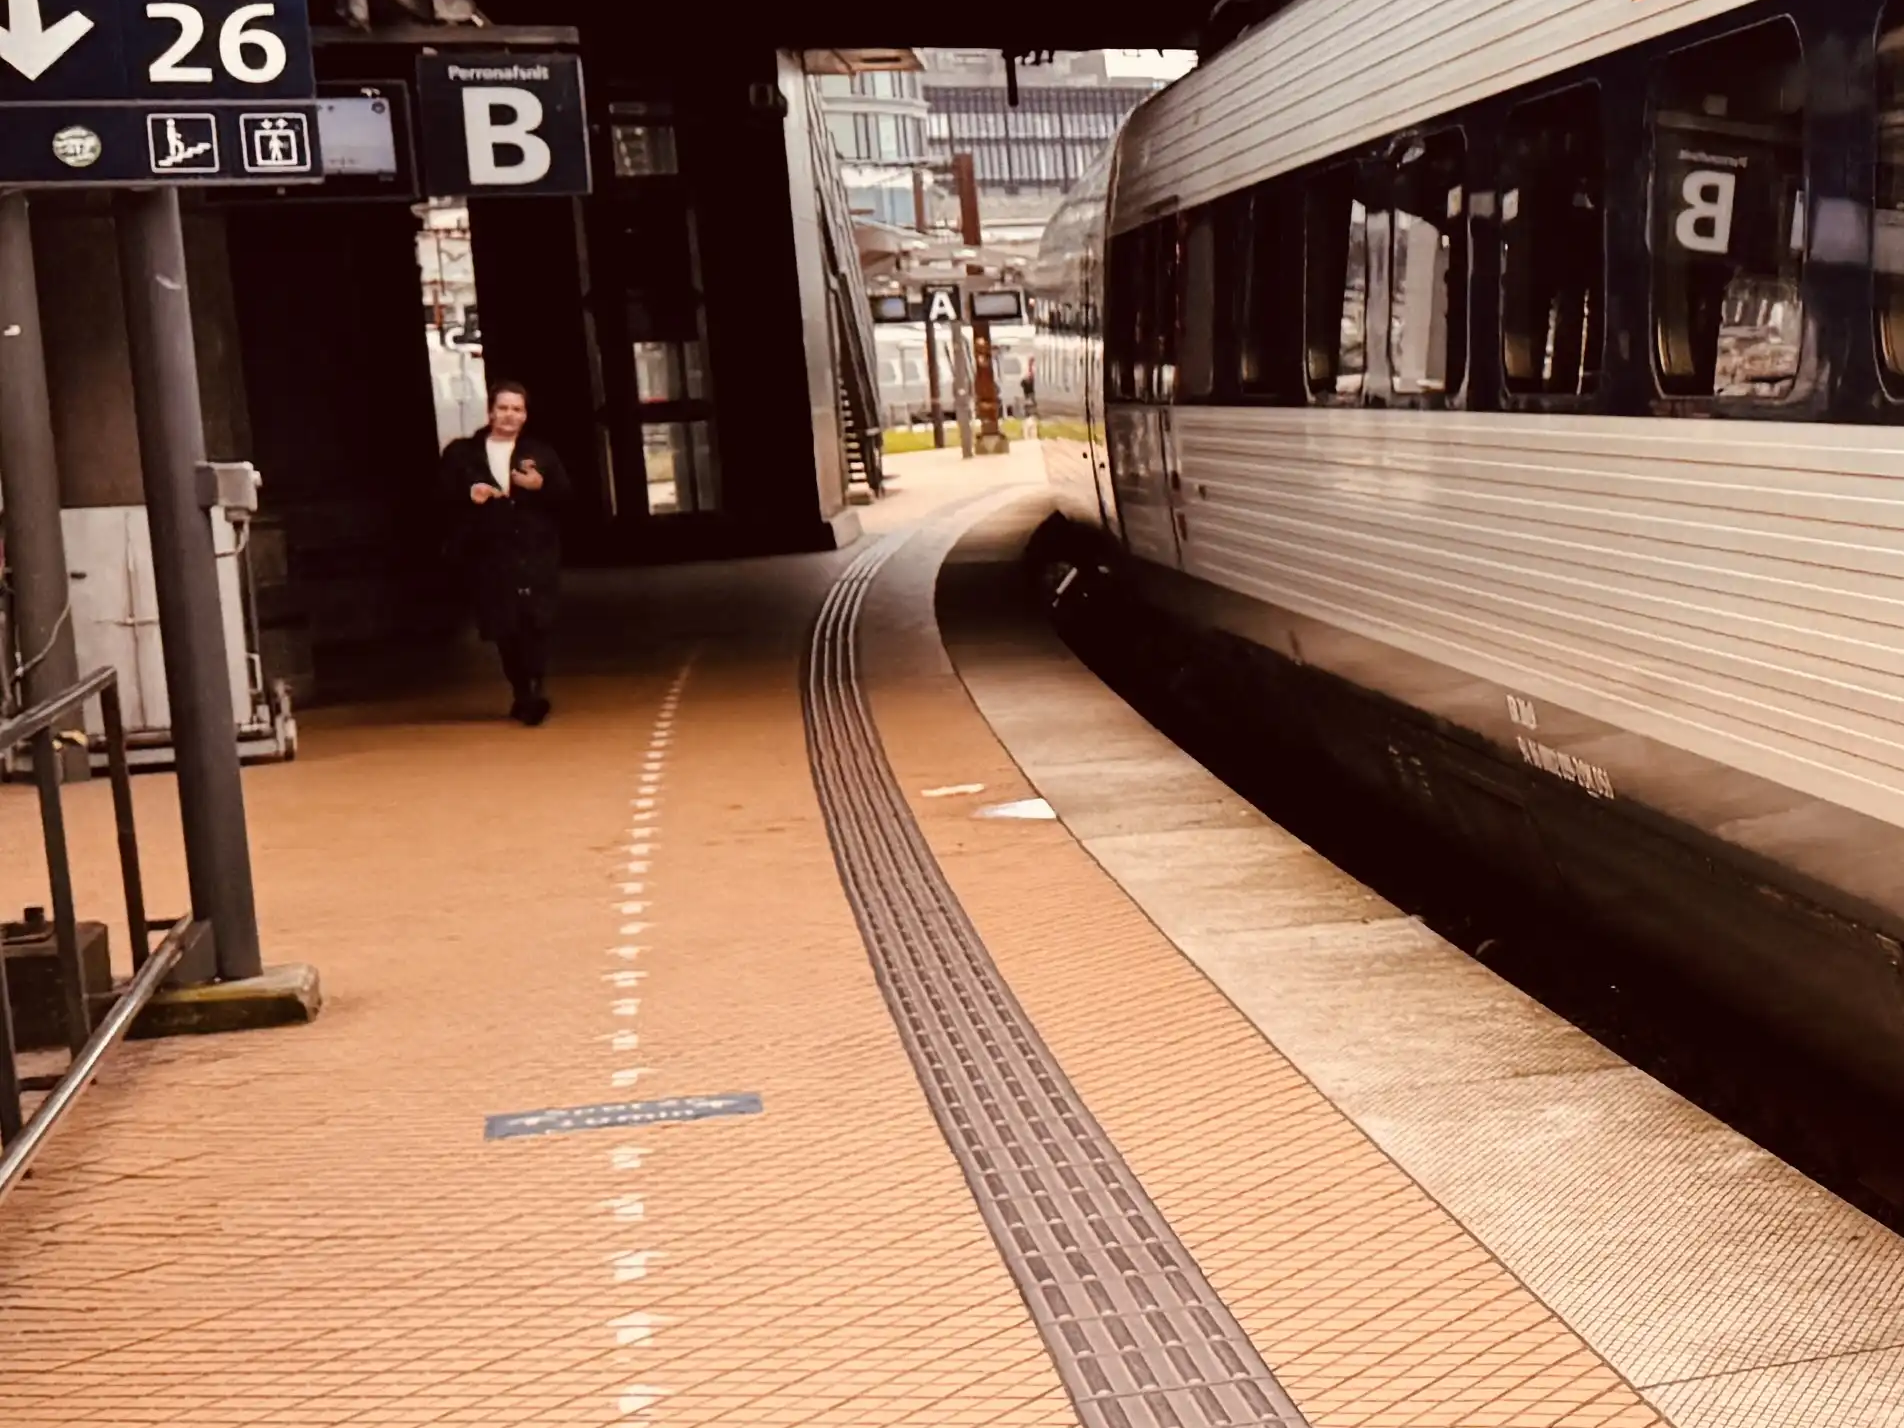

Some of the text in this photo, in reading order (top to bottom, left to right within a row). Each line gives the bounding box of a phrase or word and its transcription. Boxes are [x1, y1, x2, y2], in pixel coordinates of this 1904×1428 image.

[146, 2, 287, 83] 26
[462, 86, 551, 185] B
[929, 291, 957, 321] A
